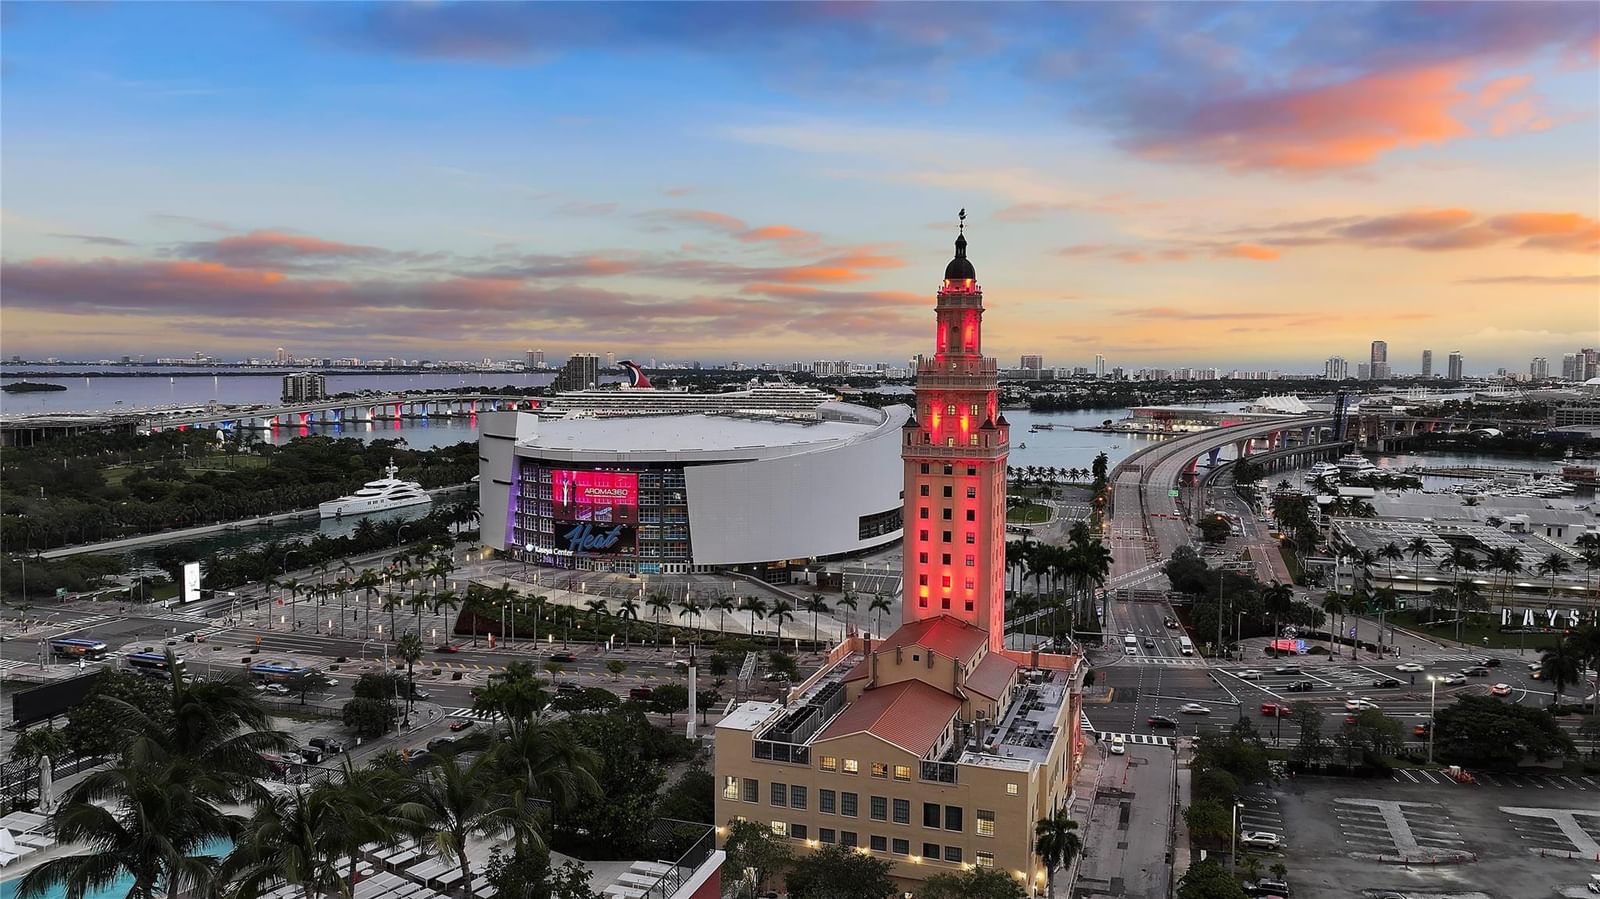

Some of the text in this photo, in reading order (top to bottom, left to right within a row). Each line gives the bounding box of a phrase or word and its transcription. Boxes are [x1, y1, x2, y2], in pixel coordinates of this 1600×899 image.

[584, 487, 628, 496] AROMA360
[563, 524, 622, 551] Heat
[553, 548, 574, 557] Center
